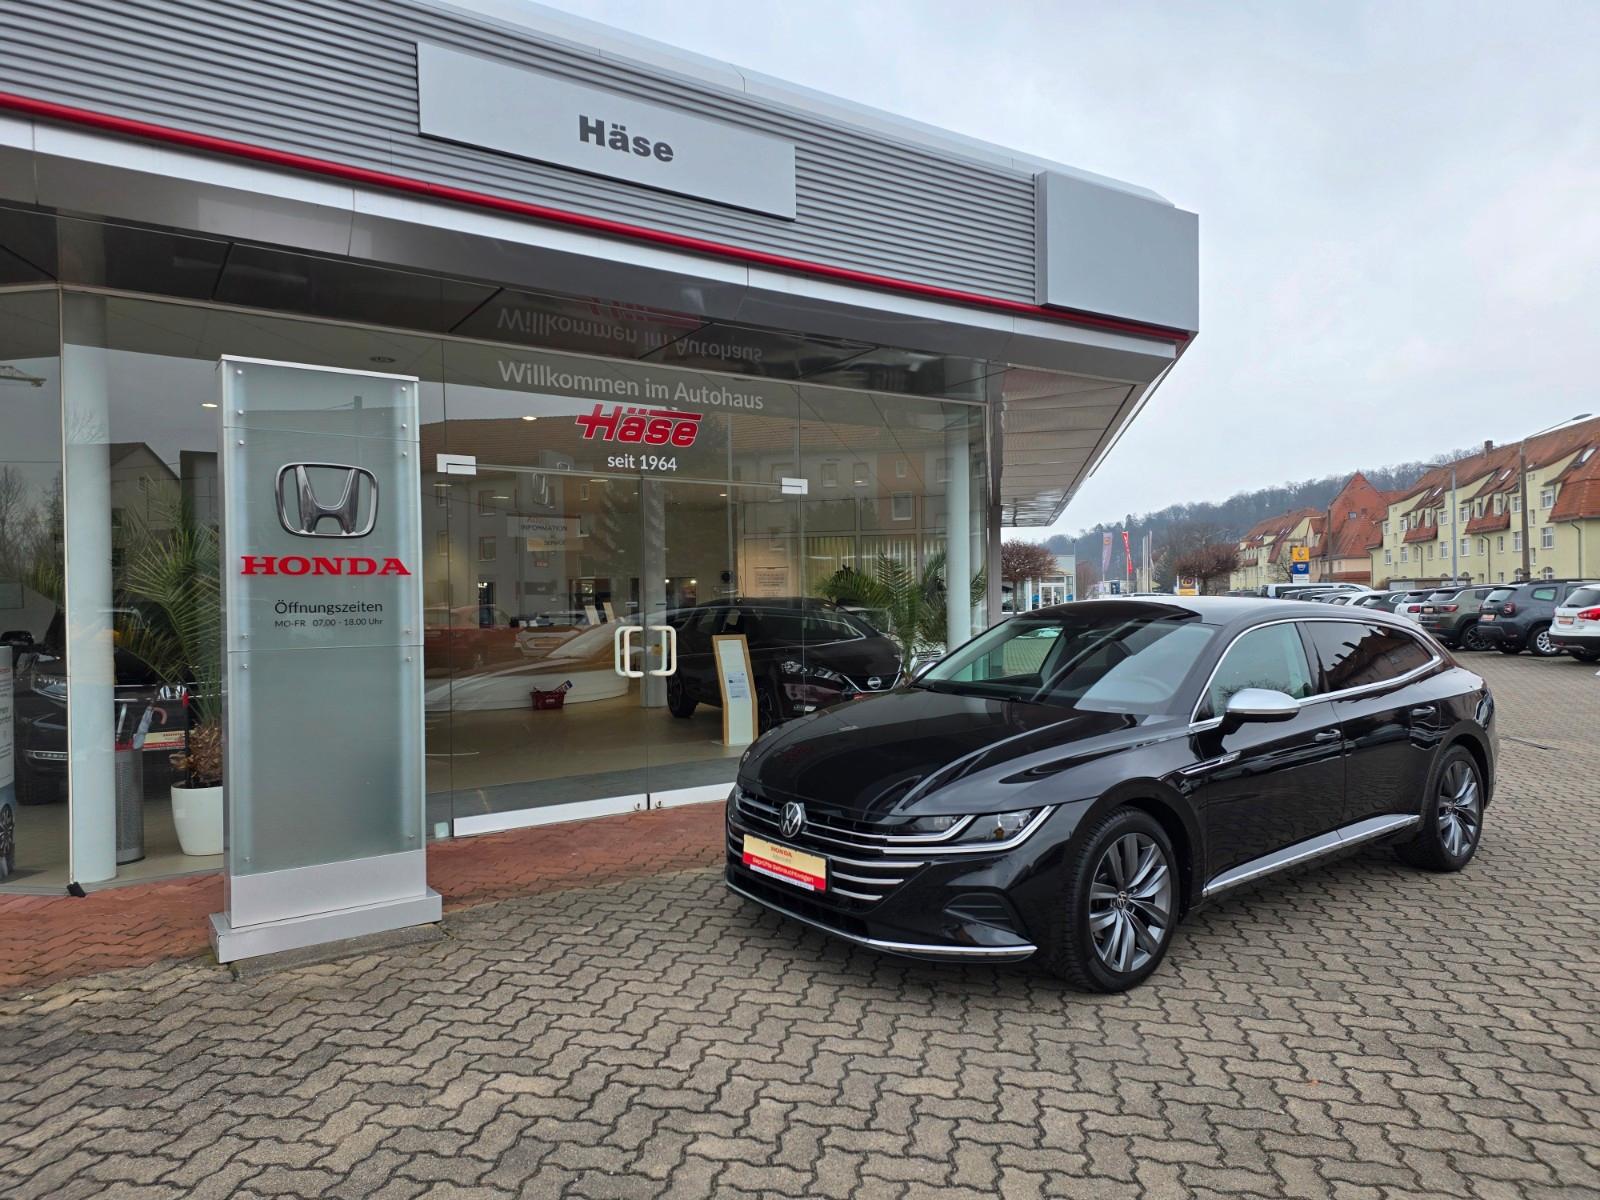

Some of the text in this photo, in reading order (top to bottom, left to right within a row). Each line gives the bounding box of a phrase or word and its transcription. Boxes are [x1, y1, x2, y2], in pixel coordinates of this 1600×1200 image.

[579, 114, 674, 162] Häse
[498, 361, 764, 409] Willkommen im Autohaus
[575, 403, 704, 447] Häse
[607, 453, 677, 471] seit 1964
[240, 555, 412, 576] HONDA
[274, 600, 383, 615] Öffnungszeiten
[274, 620, 306, 628] MO-FR
[312, 619, 336, 627] 07.00
[344, 618, 367, 626] 18.00
[369, 618, 384, 626] Uhr
